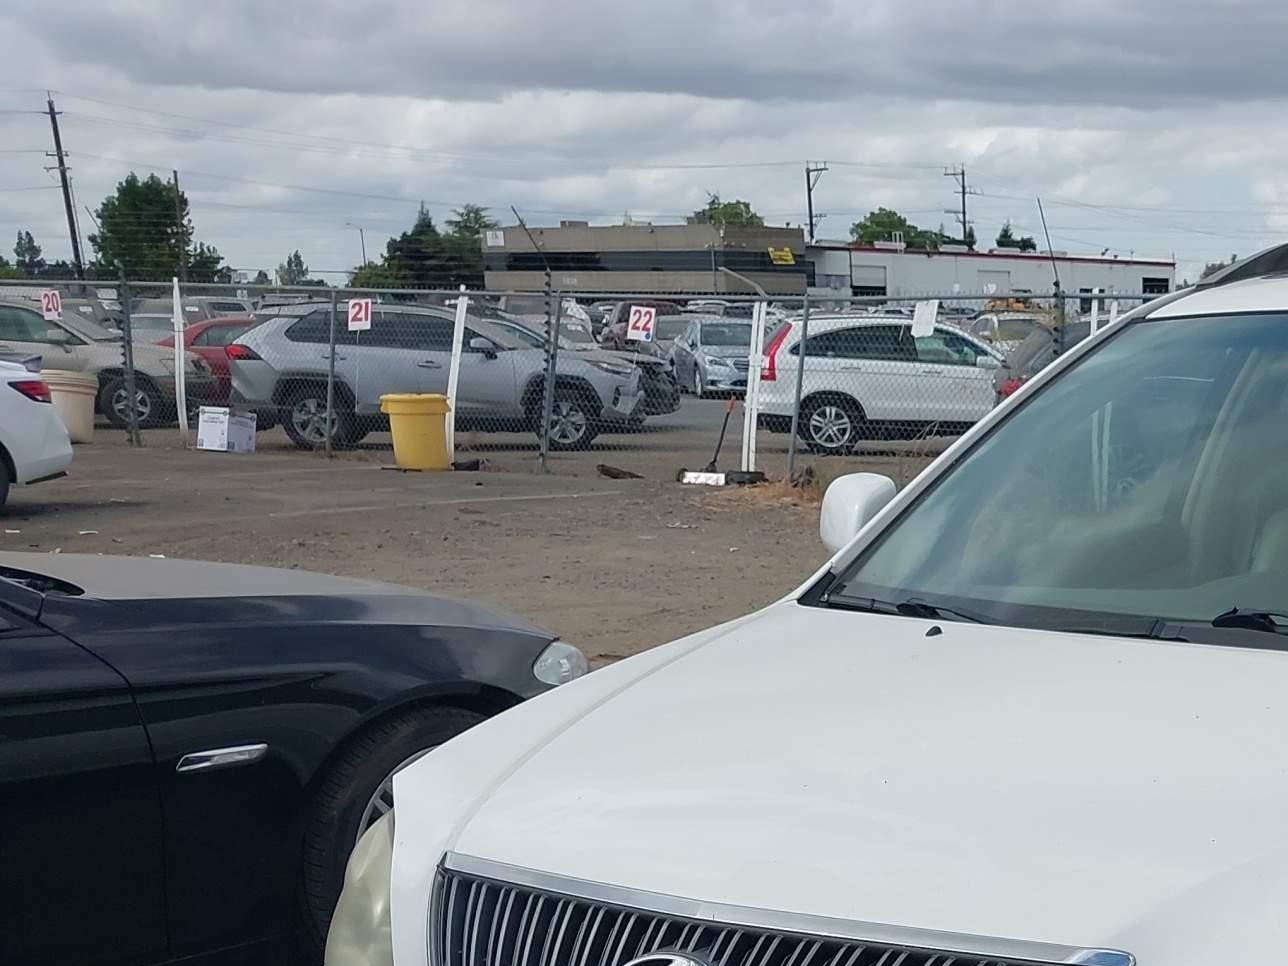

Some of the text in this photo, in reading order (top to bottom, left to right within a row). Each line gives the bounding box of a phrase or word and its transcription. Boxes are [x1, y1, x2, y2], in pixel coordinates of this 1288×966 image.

[43, 292, 59, 312] 20
[351, 302, 369, 322] 21
[631, 309, 653, 331] 22
